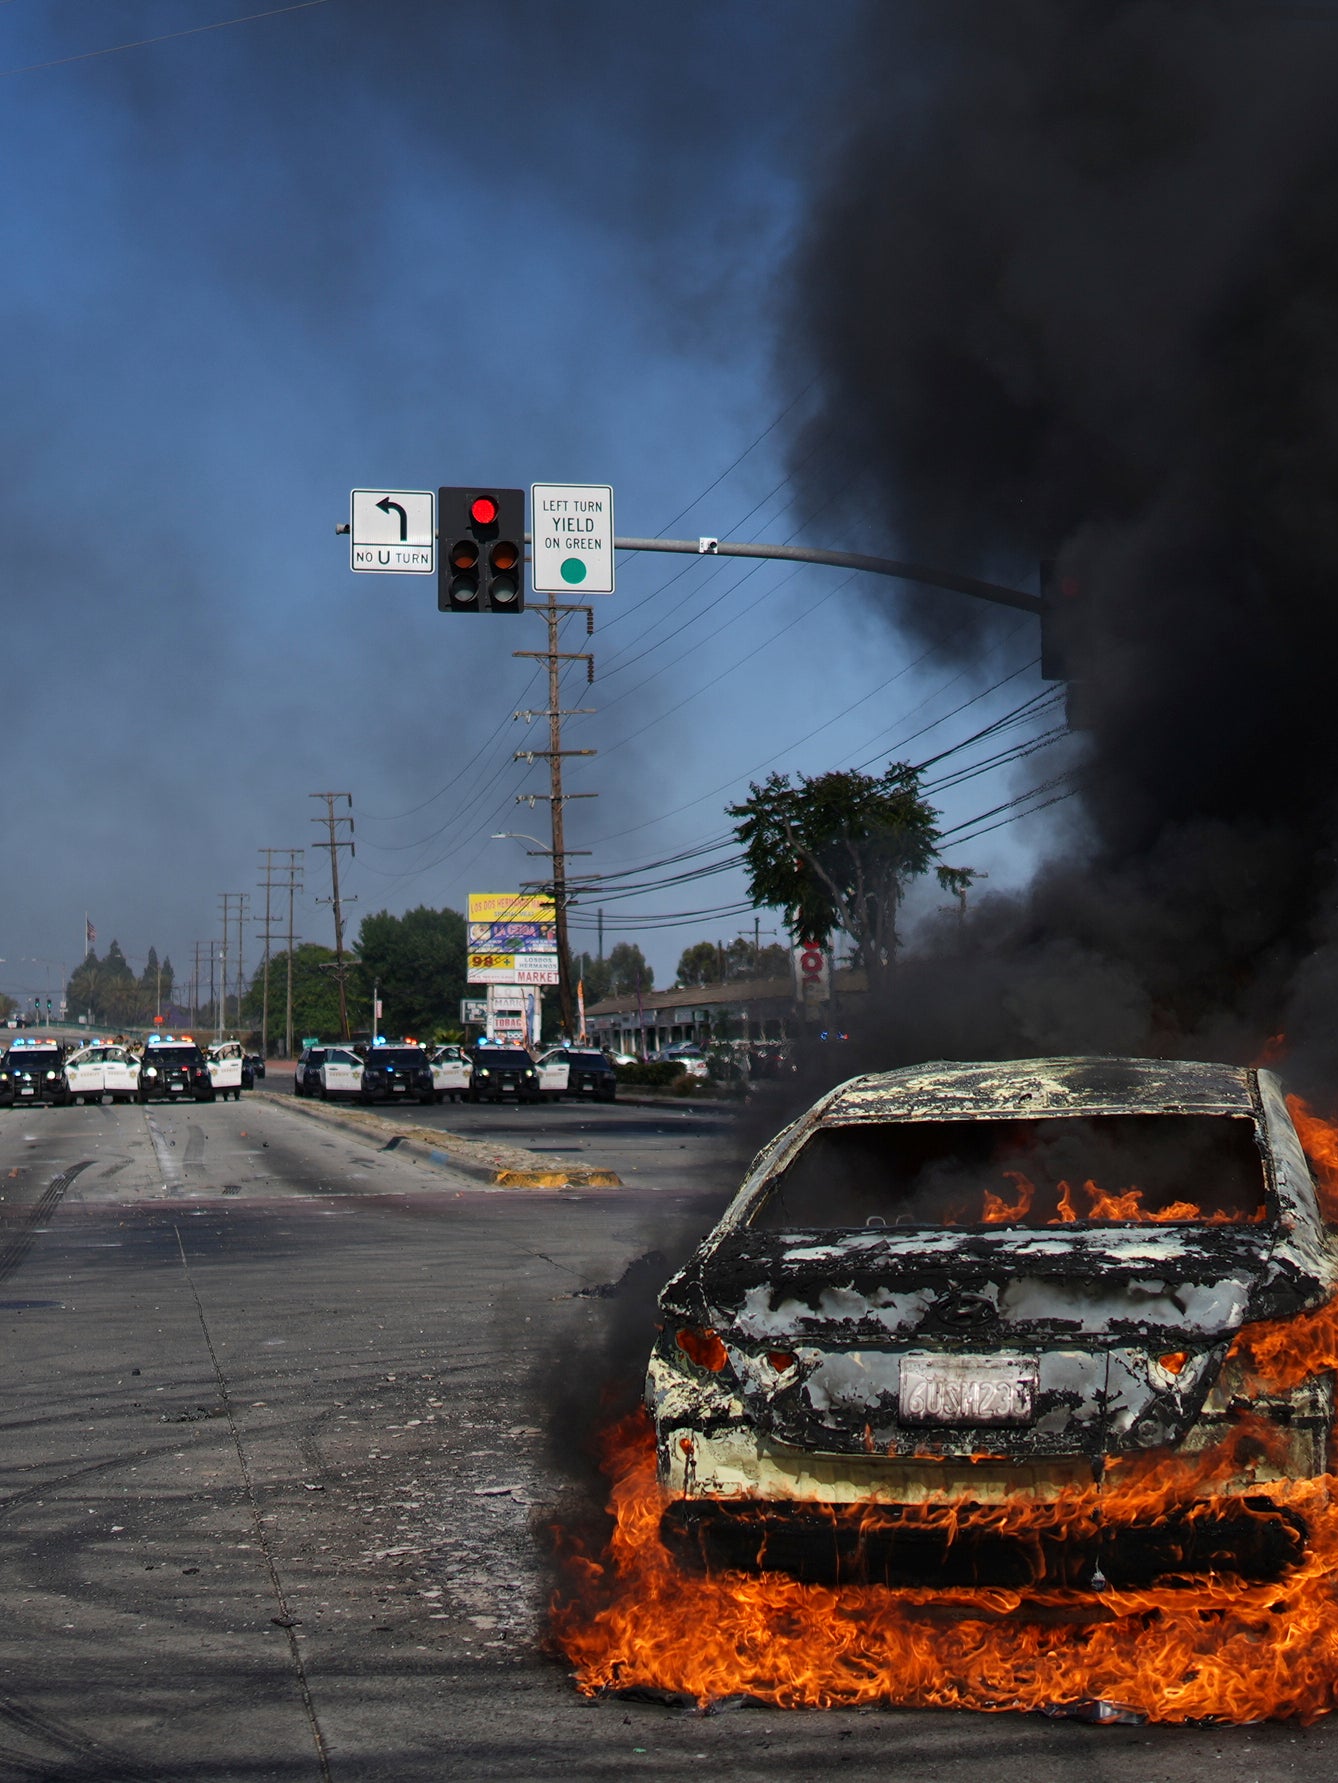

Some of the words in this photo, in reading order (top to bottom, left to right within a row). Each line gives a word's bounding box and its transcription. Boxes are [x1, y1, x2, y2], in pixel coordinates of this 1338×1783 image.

[543, 500, 570, 512] LEFT
[574, 500, 603, 512] TURN
[552, 517, 594, 533] YIELD
[545, 538, 561, 549] ON
[565, 538, 602, 549] GREEN
[356, 552, 373, 563] NO
[378, 550, 390, 565] U
[396, 553, 428, 565] TURN
[517, 971, 560, 983] MARKET
[494, 999, 523, 1008] MARK
[495, 1018, 522, 1027] TOBAC
[506, 1030, 524, 1039] boo
